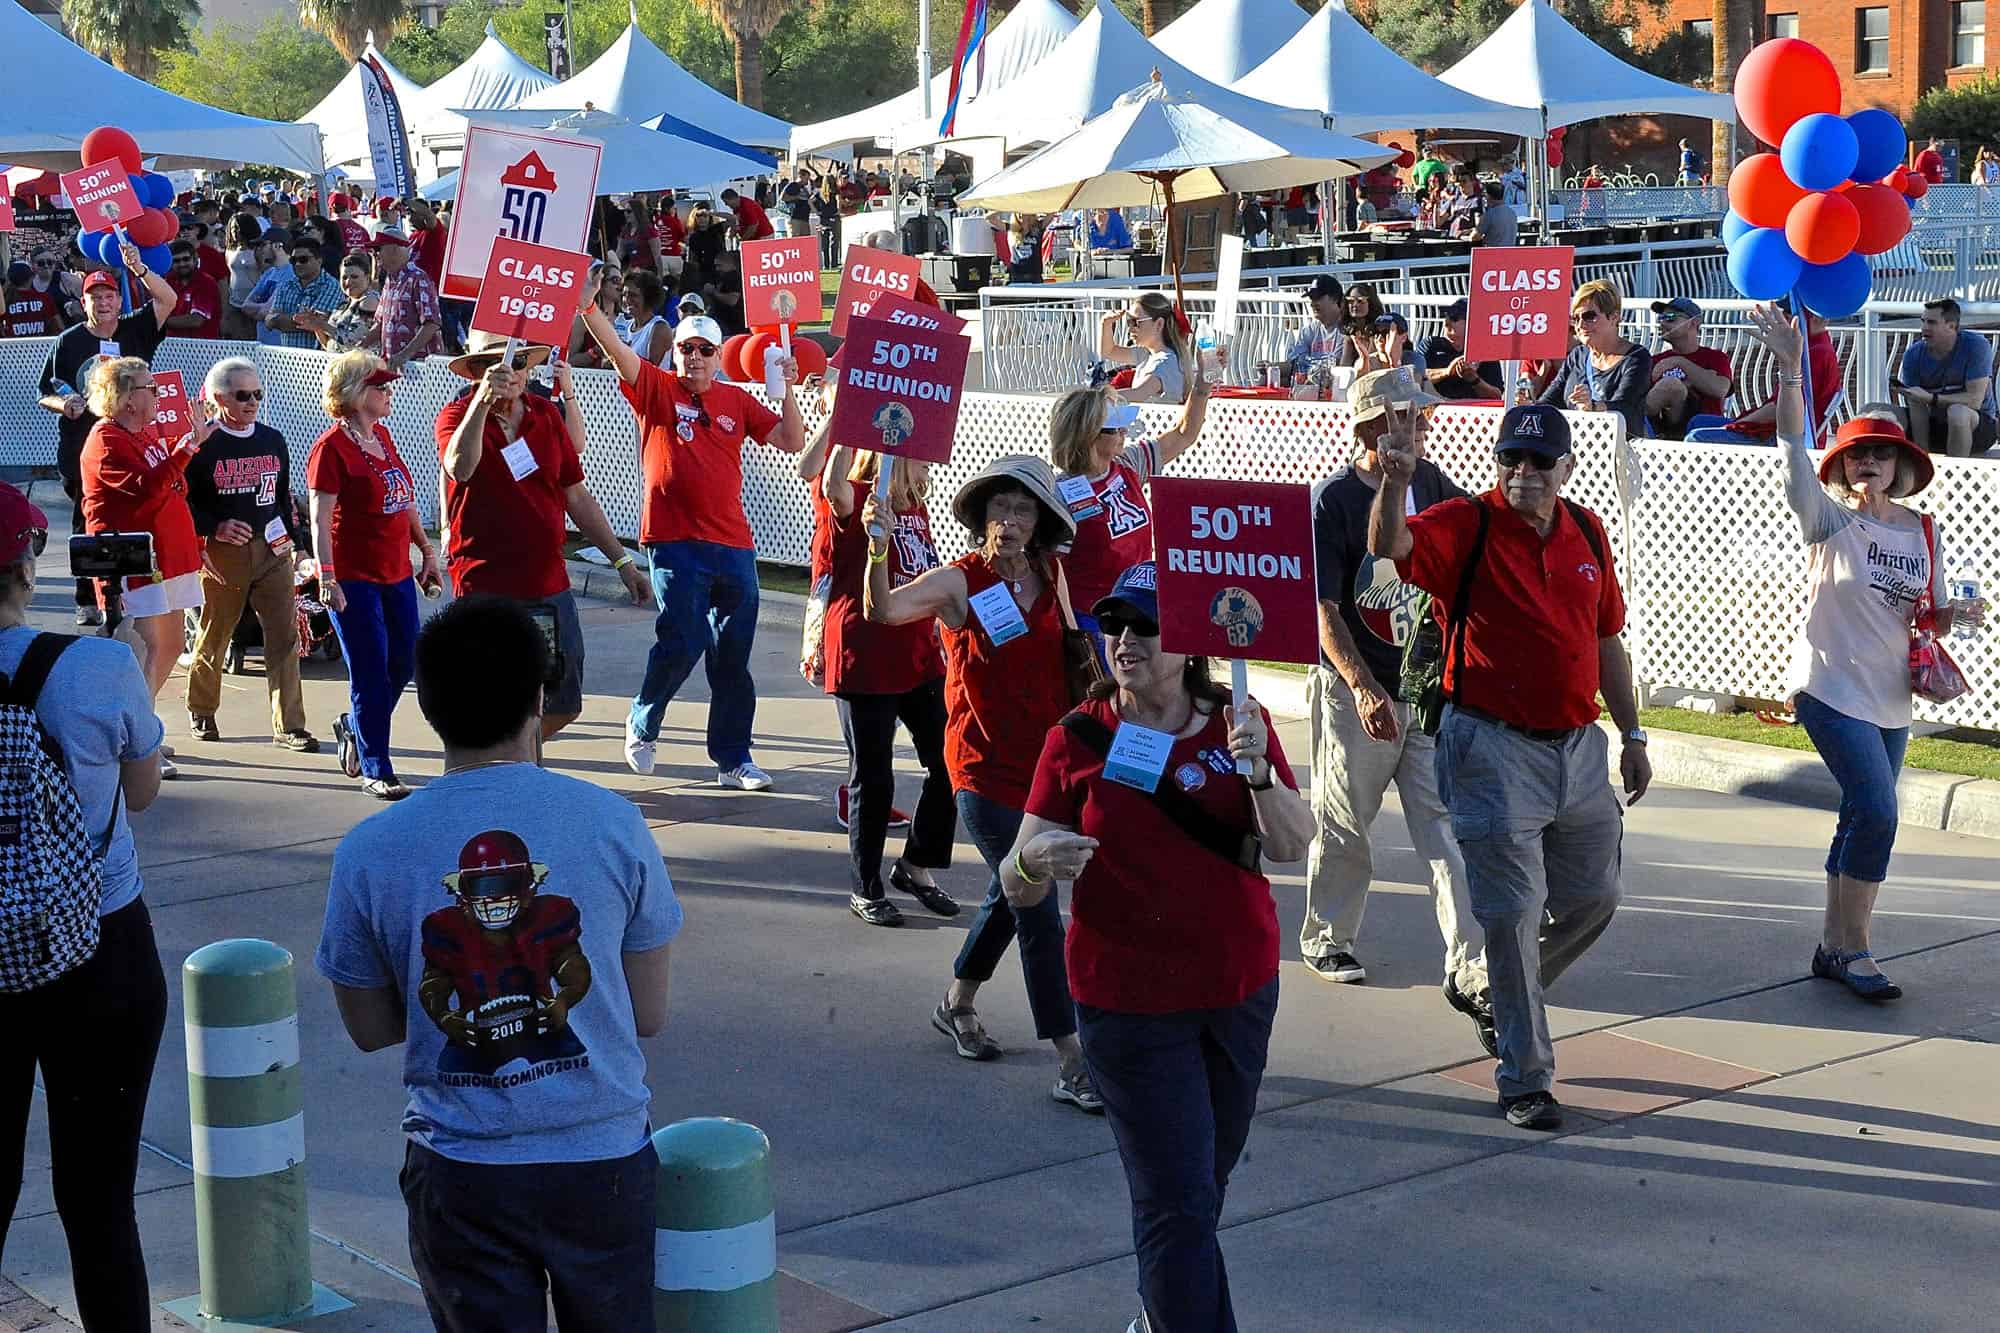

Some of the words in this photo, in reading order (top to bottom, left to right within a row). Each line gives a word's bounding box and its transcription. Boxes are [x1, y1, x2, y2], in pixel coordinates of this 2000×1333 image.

[79, 169, 111, 189] 50TH
[76, 182, 128, 206] REUNION
[760, 248, 801, 269] 50TH
[498, 257, 575, 289] CLASS
[749, 271, 815, 288] REUNION
[851, 264, 910, 291] CLASS
[1481, 268, 1561, 292] CLASS
[521, 285, 542, 298] OF
[1510, 296, 1530, 310] OF
[8, 302, 29, 314] GET
[30, 300, 44, 313] UP
[498, 295, 556, 322] 1968
[12, 321, 45, 335] DOWN
[1488, 312, 1549, 336] 1968
[872, 339, 939, 369] 50TH
[848, 367, 953, 403] REUNION
[1514, 413, 1544, 438] A
[882, 429, 900, 447] 68
[213, 454, 281, 477] ARIZONA
[256, 471, 278, 506] A
[1096, 486, 1150, 540] A
[1190, 504, 1272, 541] 50TH
[1167, 548, 1302, 580] REUNION
[1124, 564, 1157, 590] A
[1226, 623, 1249, 647] 68
[490, 1019, 524, 1041] 2018
